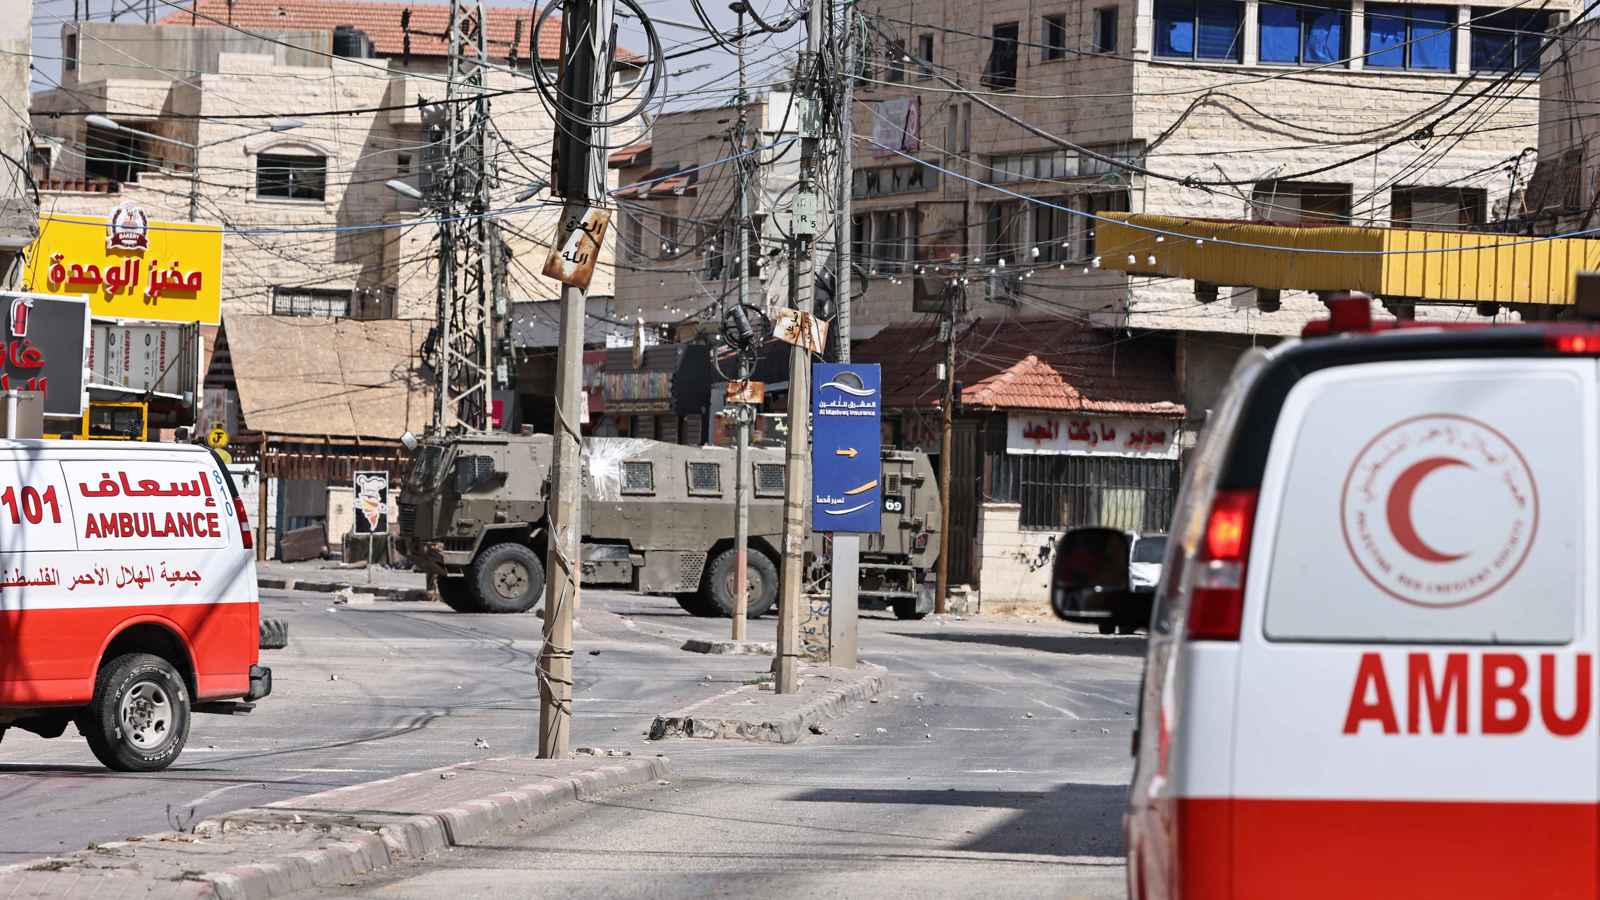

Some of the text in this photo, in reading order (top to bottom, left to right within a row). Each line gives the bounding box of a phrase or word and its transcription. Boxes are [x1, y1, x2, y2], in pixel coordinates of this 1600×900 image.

[48, 254, 202, 297] مخبز الوحدة
[1068, 420, 1116, 448] ماركت
[1, 485, 62, 525] 101
[79, 472, 216, 507] إسعاف
[212, 470, 234, 517] 810
[85, 512, 222, 538] AMBULANCE
[0, 560, 202, 591] جمعية الهلال الأحمر الفلسطين
[1342, 652, 1593, 737] AMBU
